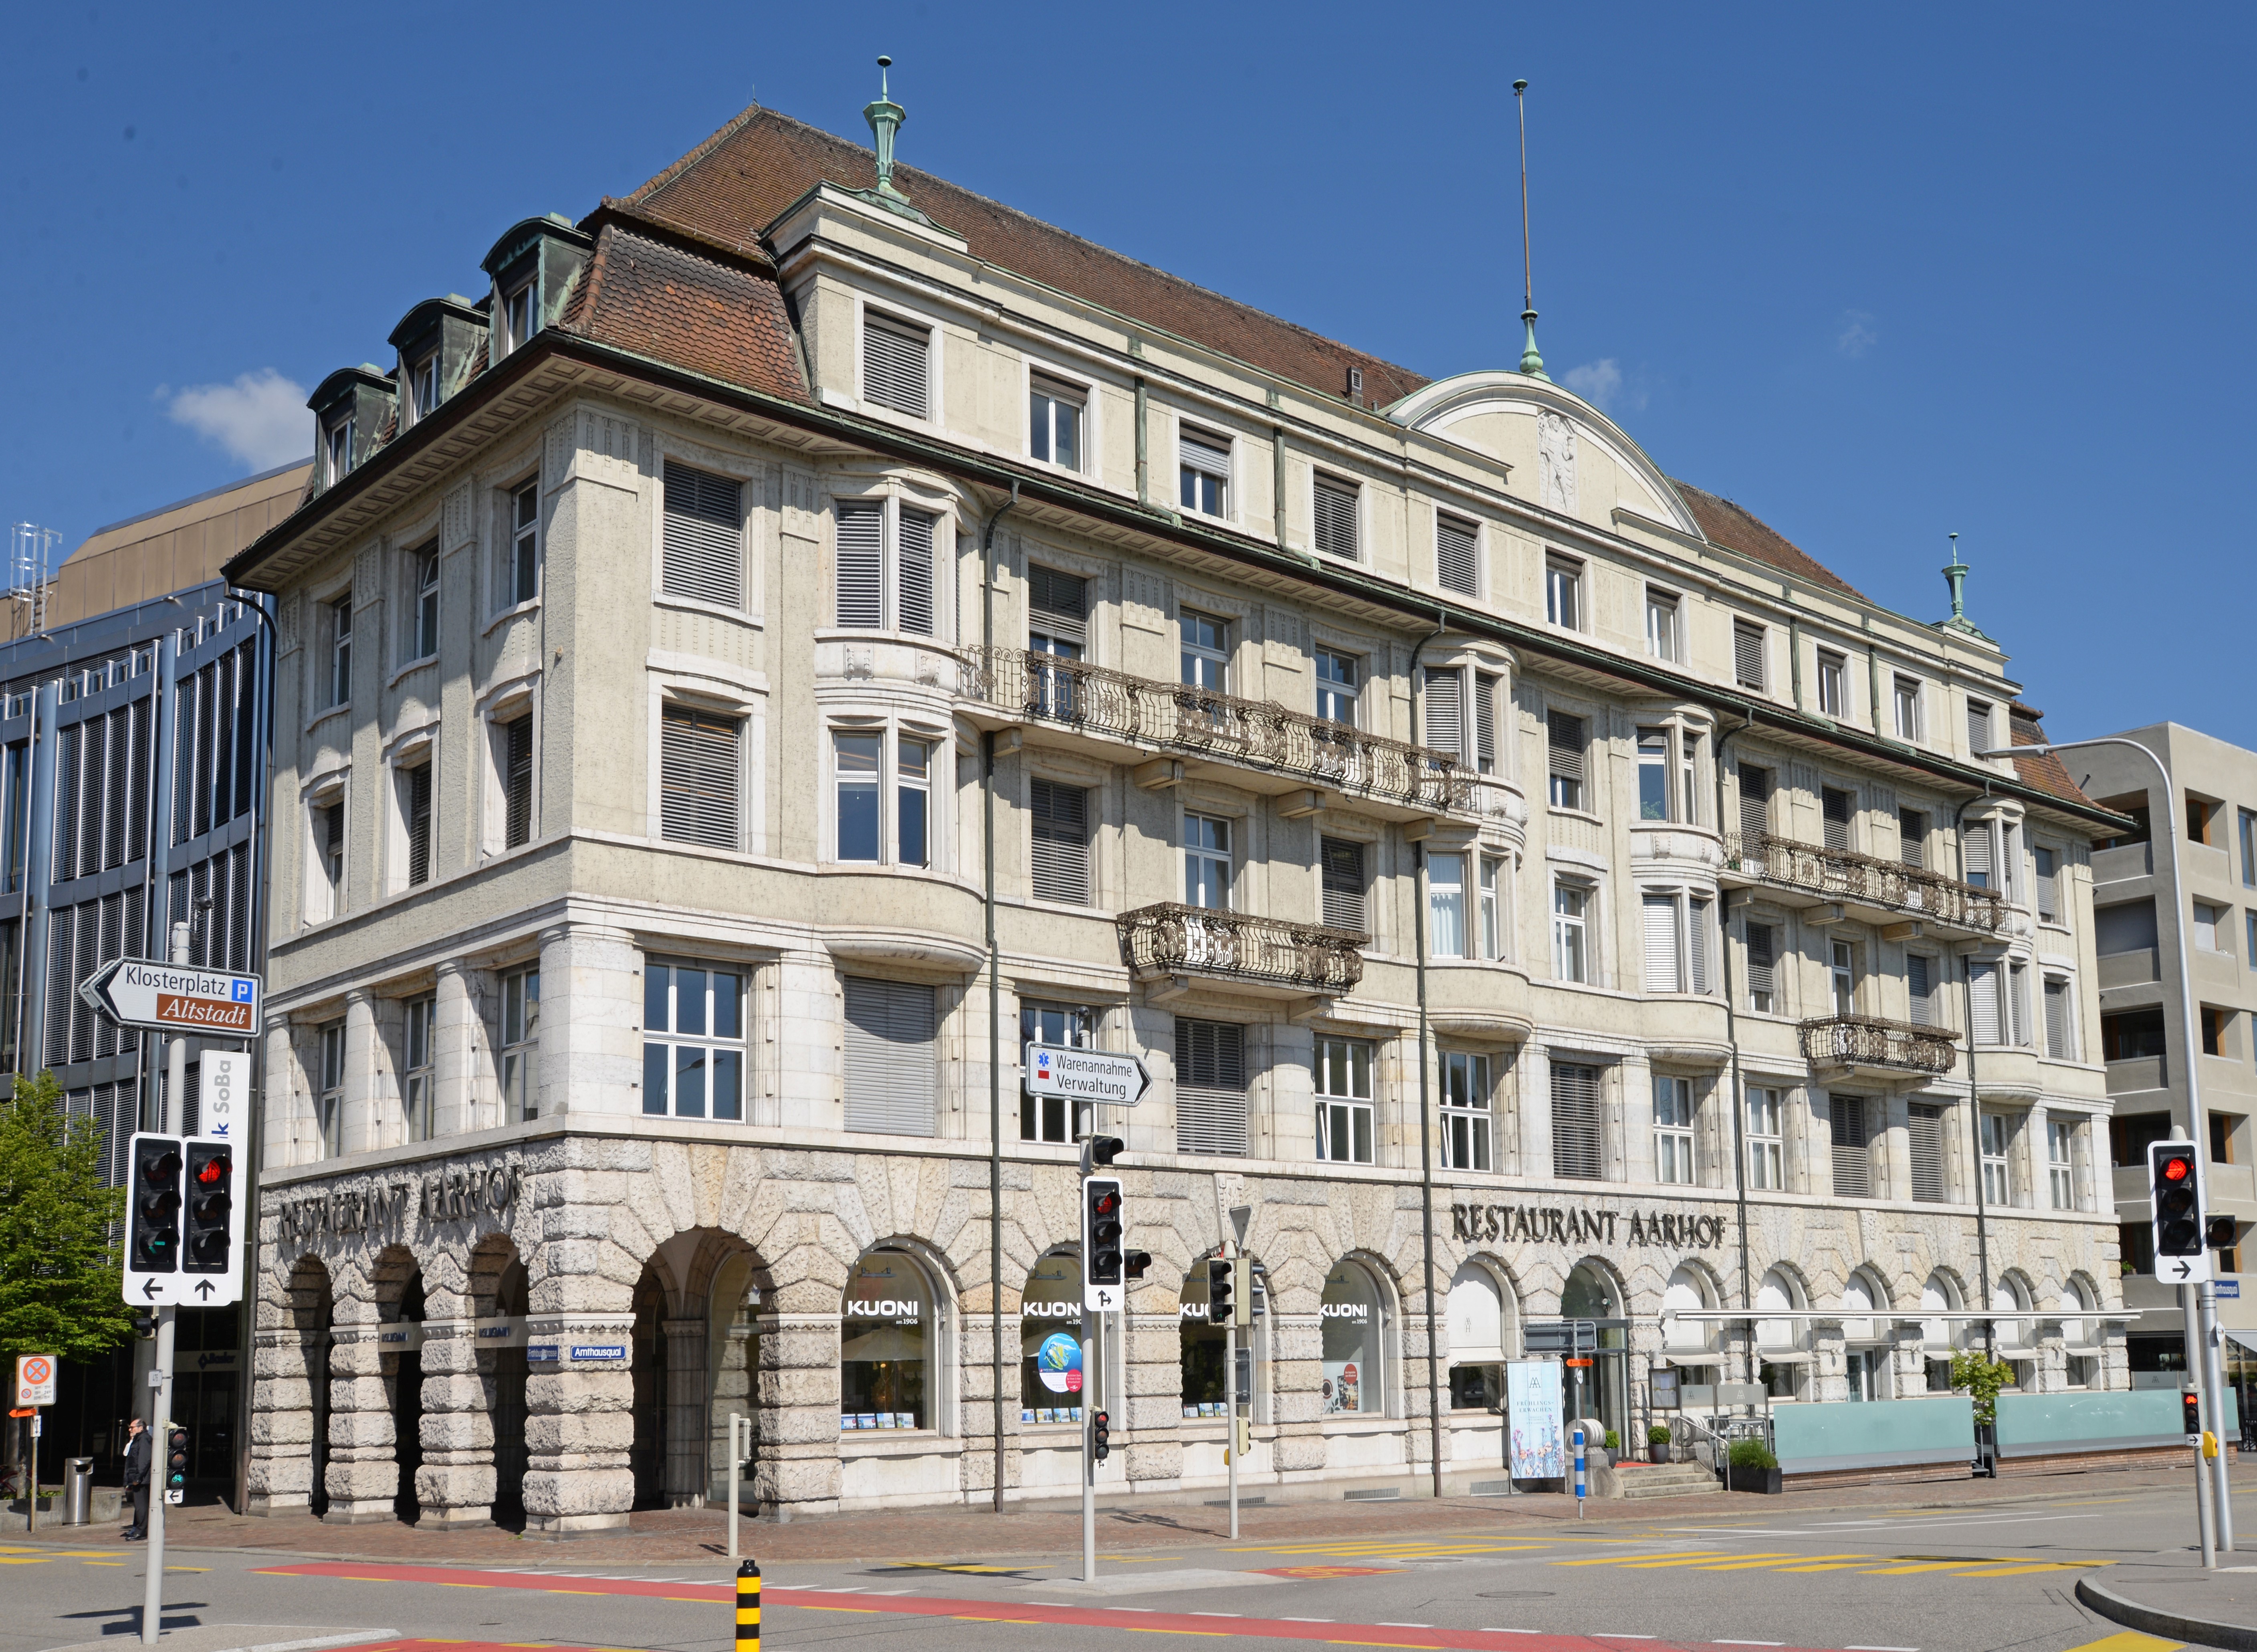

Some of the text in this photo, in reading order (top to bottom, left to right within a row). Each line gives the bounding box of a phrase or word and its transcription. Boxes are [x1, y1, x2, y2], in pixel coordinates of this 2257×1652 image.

[126, 966, 248, 999] Klosterplatz P
[162, 998, 247, 1025] Altstadt
[1056, 1054, 1132, 1077] Warenannahme
[213, 1060, 231, 1114] SoBa
[1056, 1074, 1126, 1099] Verwaltung
[280, 1164, 523, 1241] RESTAURANT AARHOF
[1451, 1203, 1727, 1245] RESTAURANT AARHOF
[2215, 1284, 2238, 1297] mthausquai
[848, 1300, 918, 1316] KUONI
[1024, 1302, 1081, 1317] KUON
[1318, 1303, 1367, 1317] KUONI
[382, 1333, 408, 1342] KUONI
[479, 1327, 510, 1338] KUONI
[575, 1347, 621, 1358] Amthausquai
